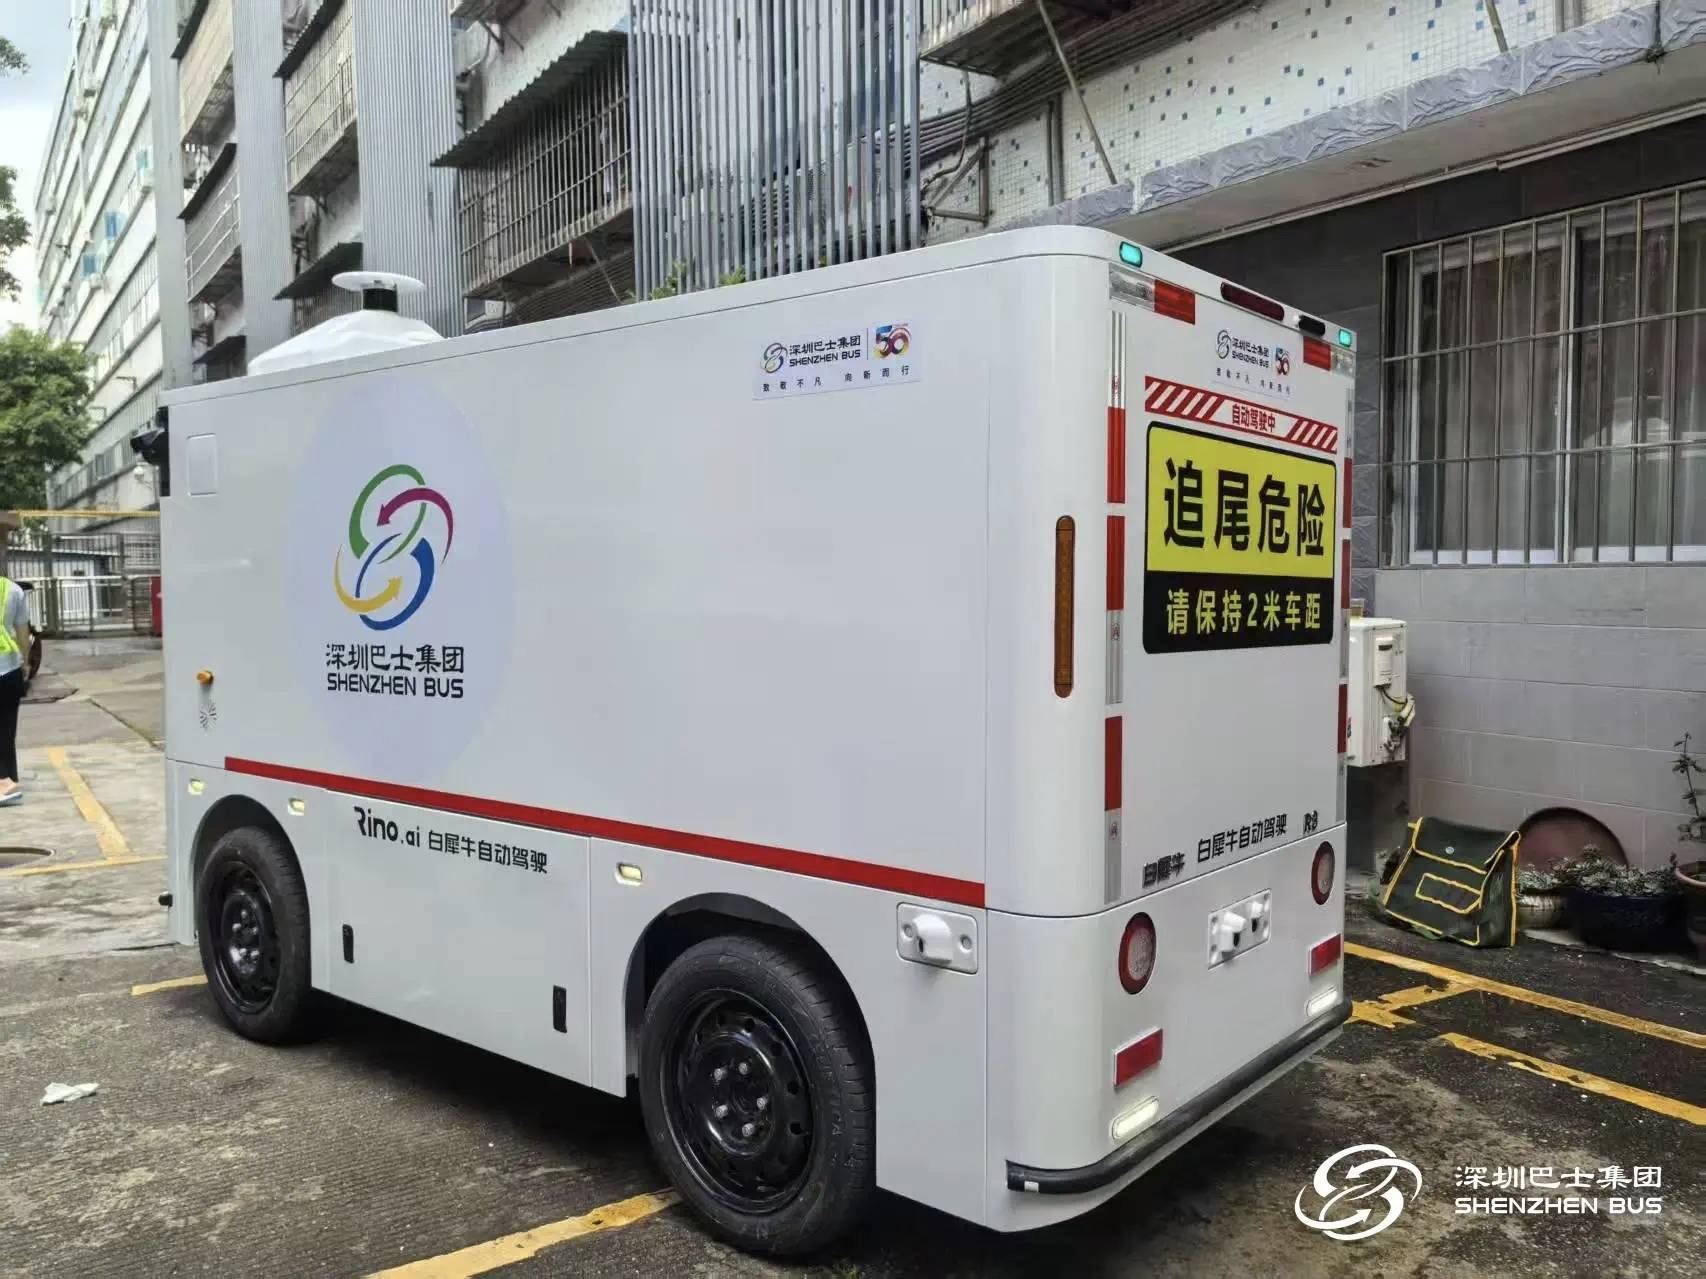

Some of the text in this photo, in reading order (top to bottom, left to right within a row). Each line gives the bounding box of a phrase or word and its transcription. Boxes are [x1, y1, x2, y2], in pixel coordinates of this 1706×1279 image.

[789, 335, 861, 356] 深圳巴士集团
[789, 349, 861, 367] SHENZHEN BUS
[1232, 338, 1270, 358] 深圳巴士集团
[1259, 357, 1270, 368] BUS
[1232, 404, 1276, 432] 自动驾驶中
[1164, 457, 1326, 557] 追尾危险
[1167, 589, 1321, 635] 请保持2米车距
[326, 644, 464, 674] 深圳巴士集团
[327, 673, 464, 699] SHENZHEN BUS
[354, 806, 548, 874] Rino.ai 白犀牛自动驾驶
[1142, 852, 1185, 888] 白犀牛
[1197, 814, 1287, 863] 白犀牛自动驾驶
